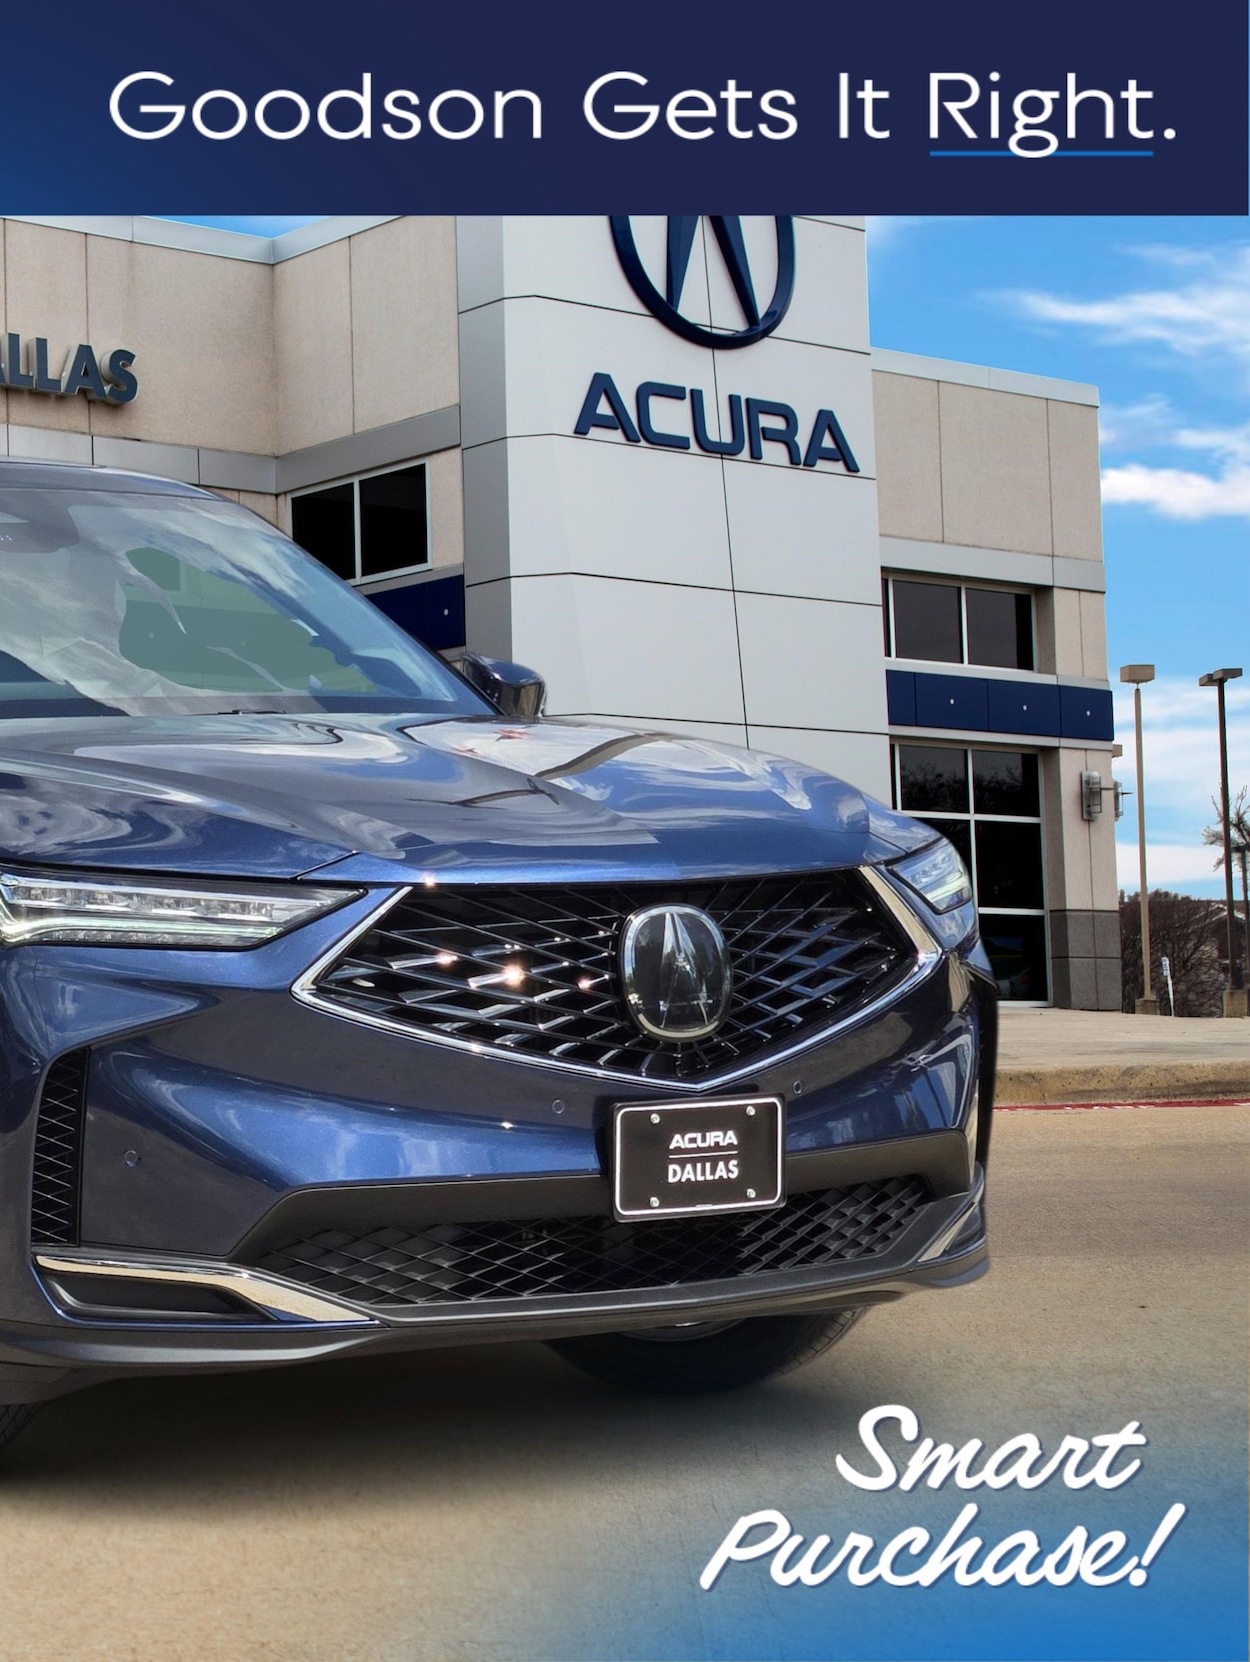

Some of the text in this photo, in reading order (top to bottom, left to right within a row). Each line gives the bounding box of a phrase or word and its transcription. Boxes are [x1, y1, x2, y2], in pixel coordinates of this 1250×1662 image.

[574, 372, 860, 473] ACURA
[668, 1130, 738, 1150] ACURA
[667, 1159, 739, 1183] DALLAS
